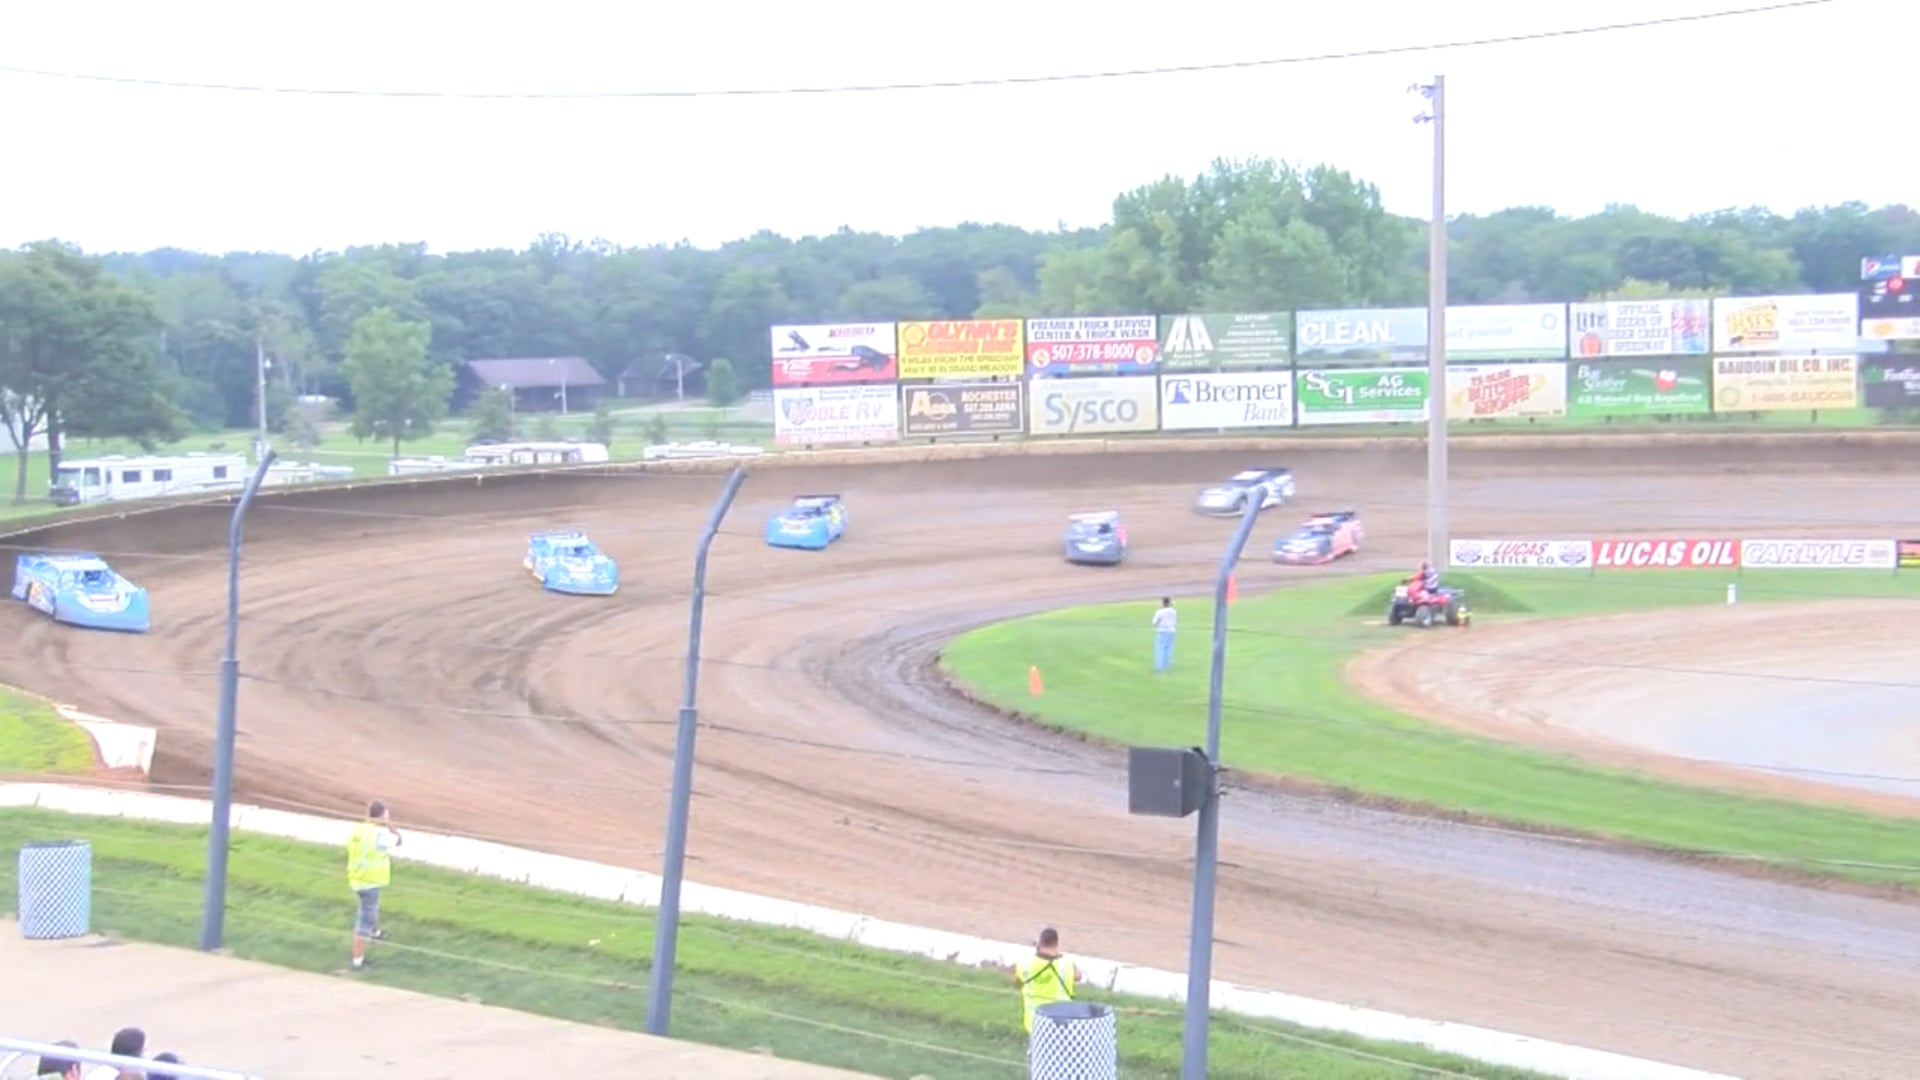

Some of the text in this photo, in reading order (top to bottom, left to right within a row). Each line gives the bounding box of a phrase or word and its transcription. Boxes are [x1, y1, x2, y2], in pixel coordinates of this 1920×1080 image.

[1031, 319, 1151, 331] PREMIER TRUCK SERVICE
[1034, 331, 1071, 340] CENTER
[1086, 329, 1117, 339] TRUCK
[1301, 320, 1396, 346] CLEAN.
[1051, 343, 1134, 359] 507-378-8000
[1378, 375, 1404, 387] AG
[1195, 380, 1288, 403] Bremer
[1359, 387, 1421, 399] Services
[1243, 402, 1288, 422] Bank
[1492, 542, 1549, 557] LUCAS
[1597, 541, 1734, 566] LUCAS OIL
[1744, 543, 1866, 565] CARLYLE
[1483, 555, 1557, 565] CATTLE CO.
